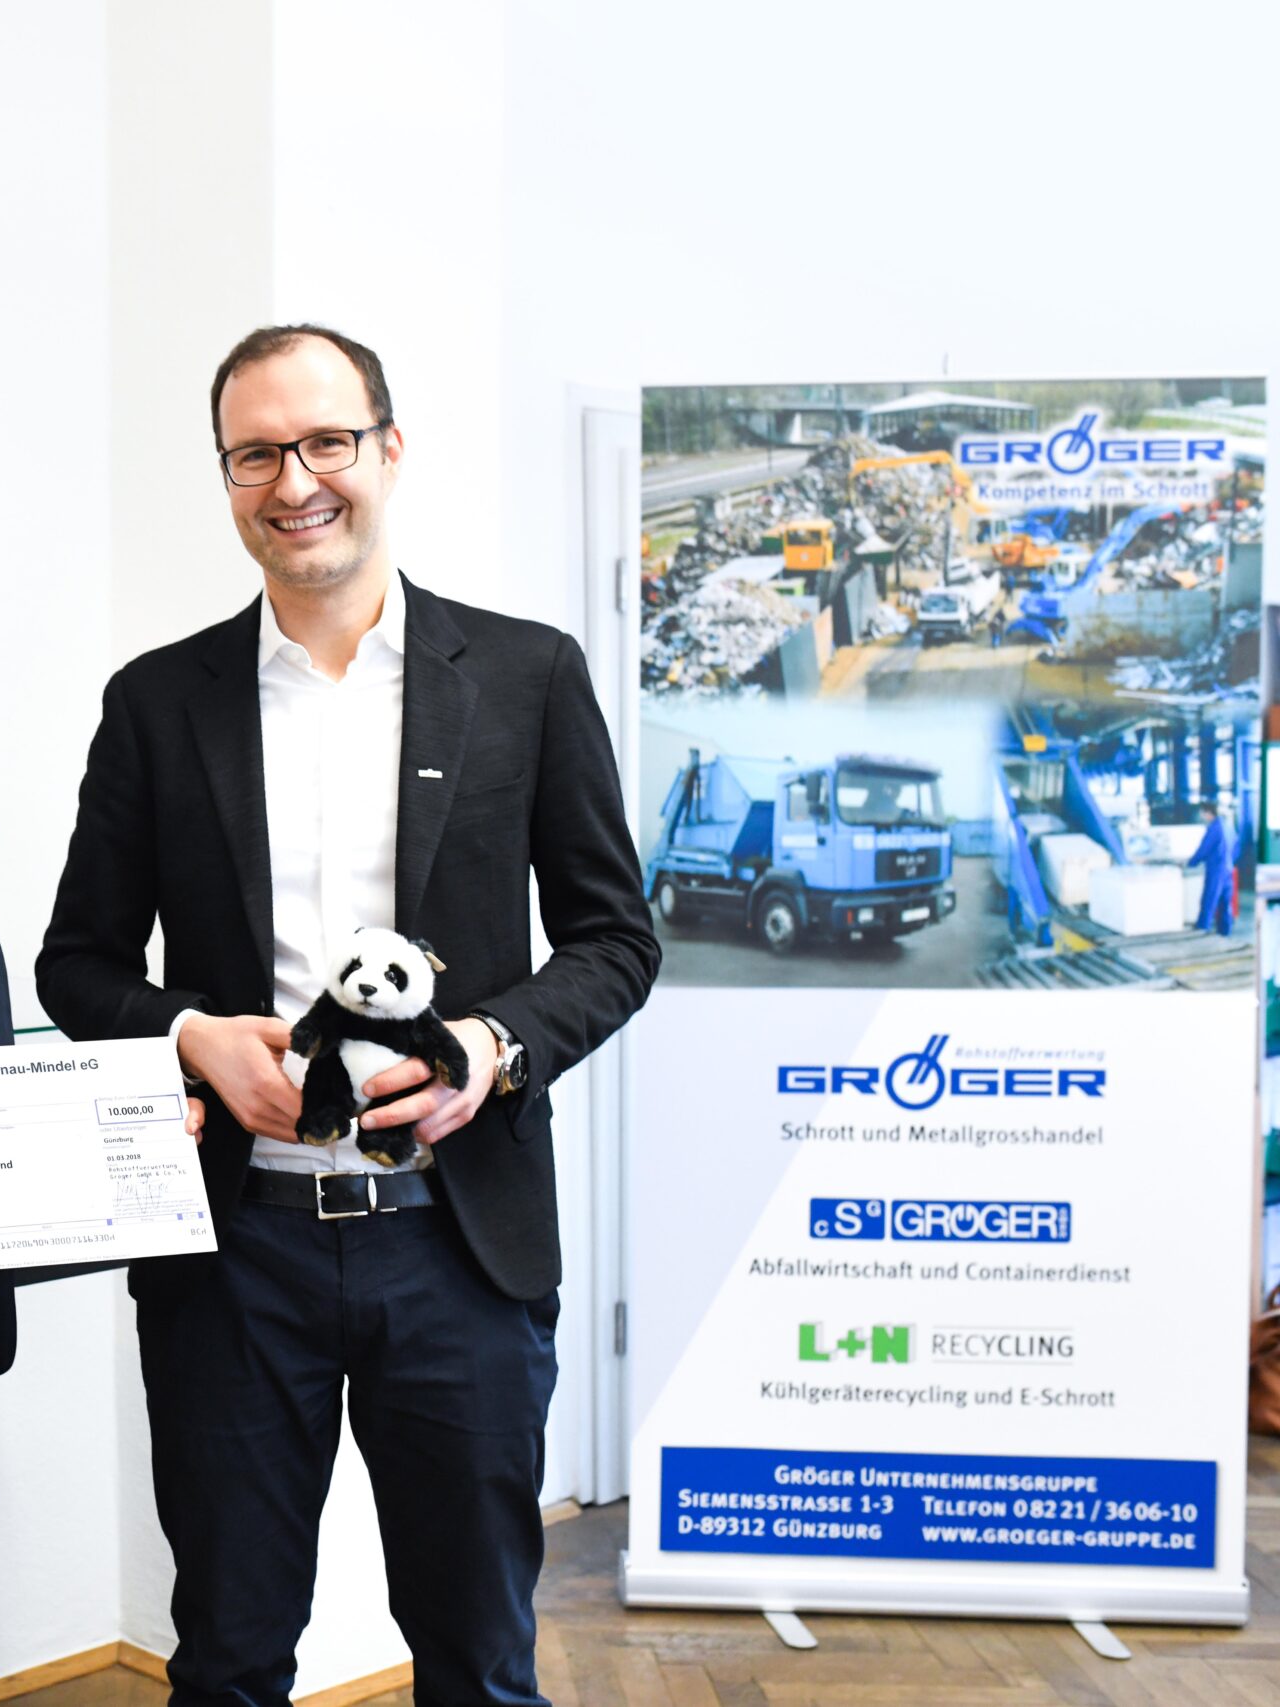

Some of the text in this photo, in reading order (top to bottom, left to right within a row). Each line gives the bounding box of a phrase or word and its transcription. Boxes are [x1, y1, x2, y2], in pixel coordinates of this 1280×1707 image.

[978, 480, 1210, 501] Kompetenz im Schrott
[80, 1058, 100, 1071] eG
[107, 1105, 155, 1117] 10.000,00
[103, 1136, 134, 1144] Günzburg
[780, 1121, 1104, 1147] Schrott und Metallgrosshandel
[106, 1153, 142, 1162] 01.03.2018
[748, 1258, 1131, 1283] Abfallwirtschaft und Containerdienst
[931, 1333, 1074, 1358] RECYCLING
[760, 1380, 1116, 1408] Kühlgeräterecycling und E-Schrott
[860, 1494, 895, 1514] 1-3
[677, 1517, 766, 1537] D-89312
